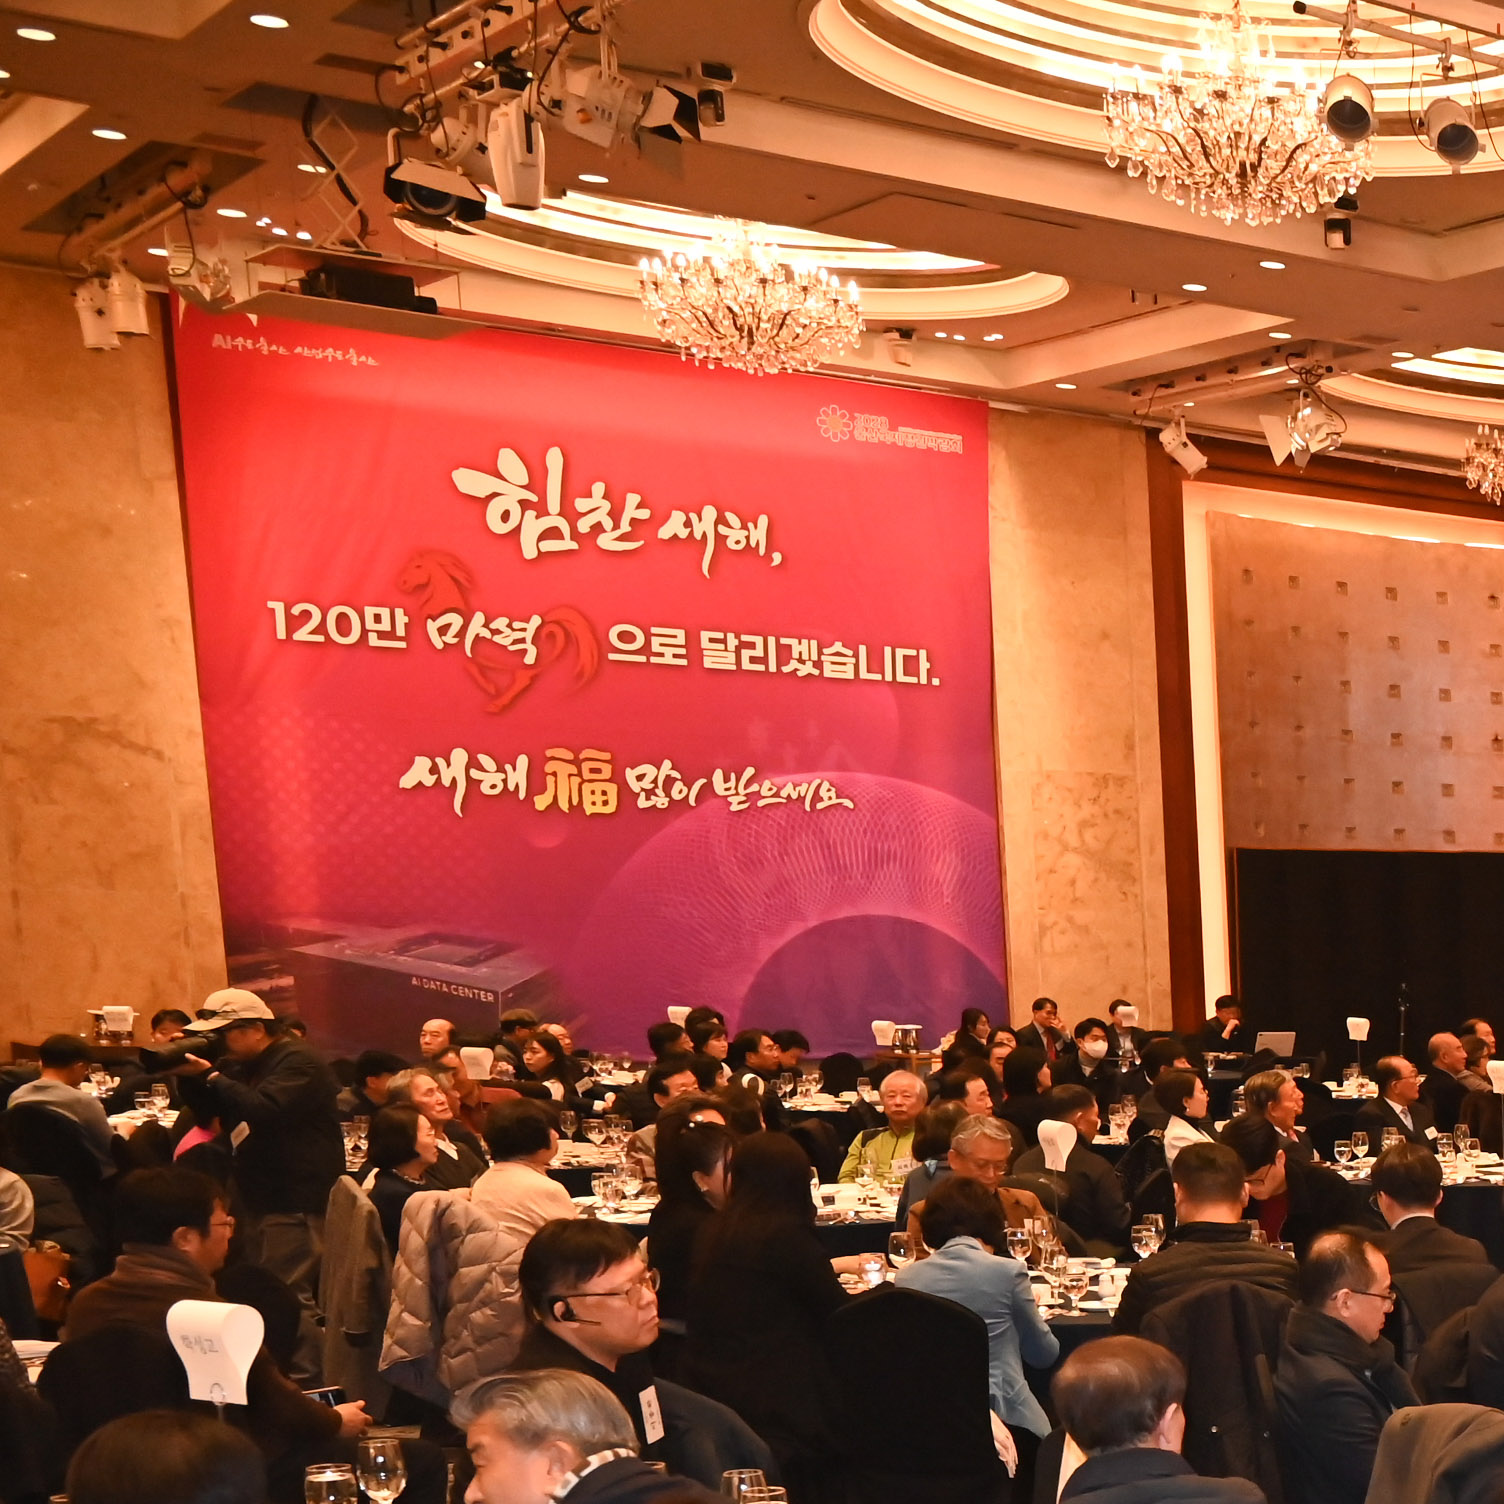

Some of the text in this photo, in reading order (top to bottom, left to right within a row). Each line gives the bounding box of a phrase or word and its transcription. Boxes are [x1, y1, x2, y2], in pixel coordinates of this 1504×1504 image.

[450, 445, 784, 580] 힘찬 새해,
[266, 600, 942, 688] 120만 마력 으로 달리겠습니다.
[398, 746, 856, 819] 새해 福 많이 받으세요
[422, 978, 449, 994] DATA
[450, 984, 495, 1003] CENTER
